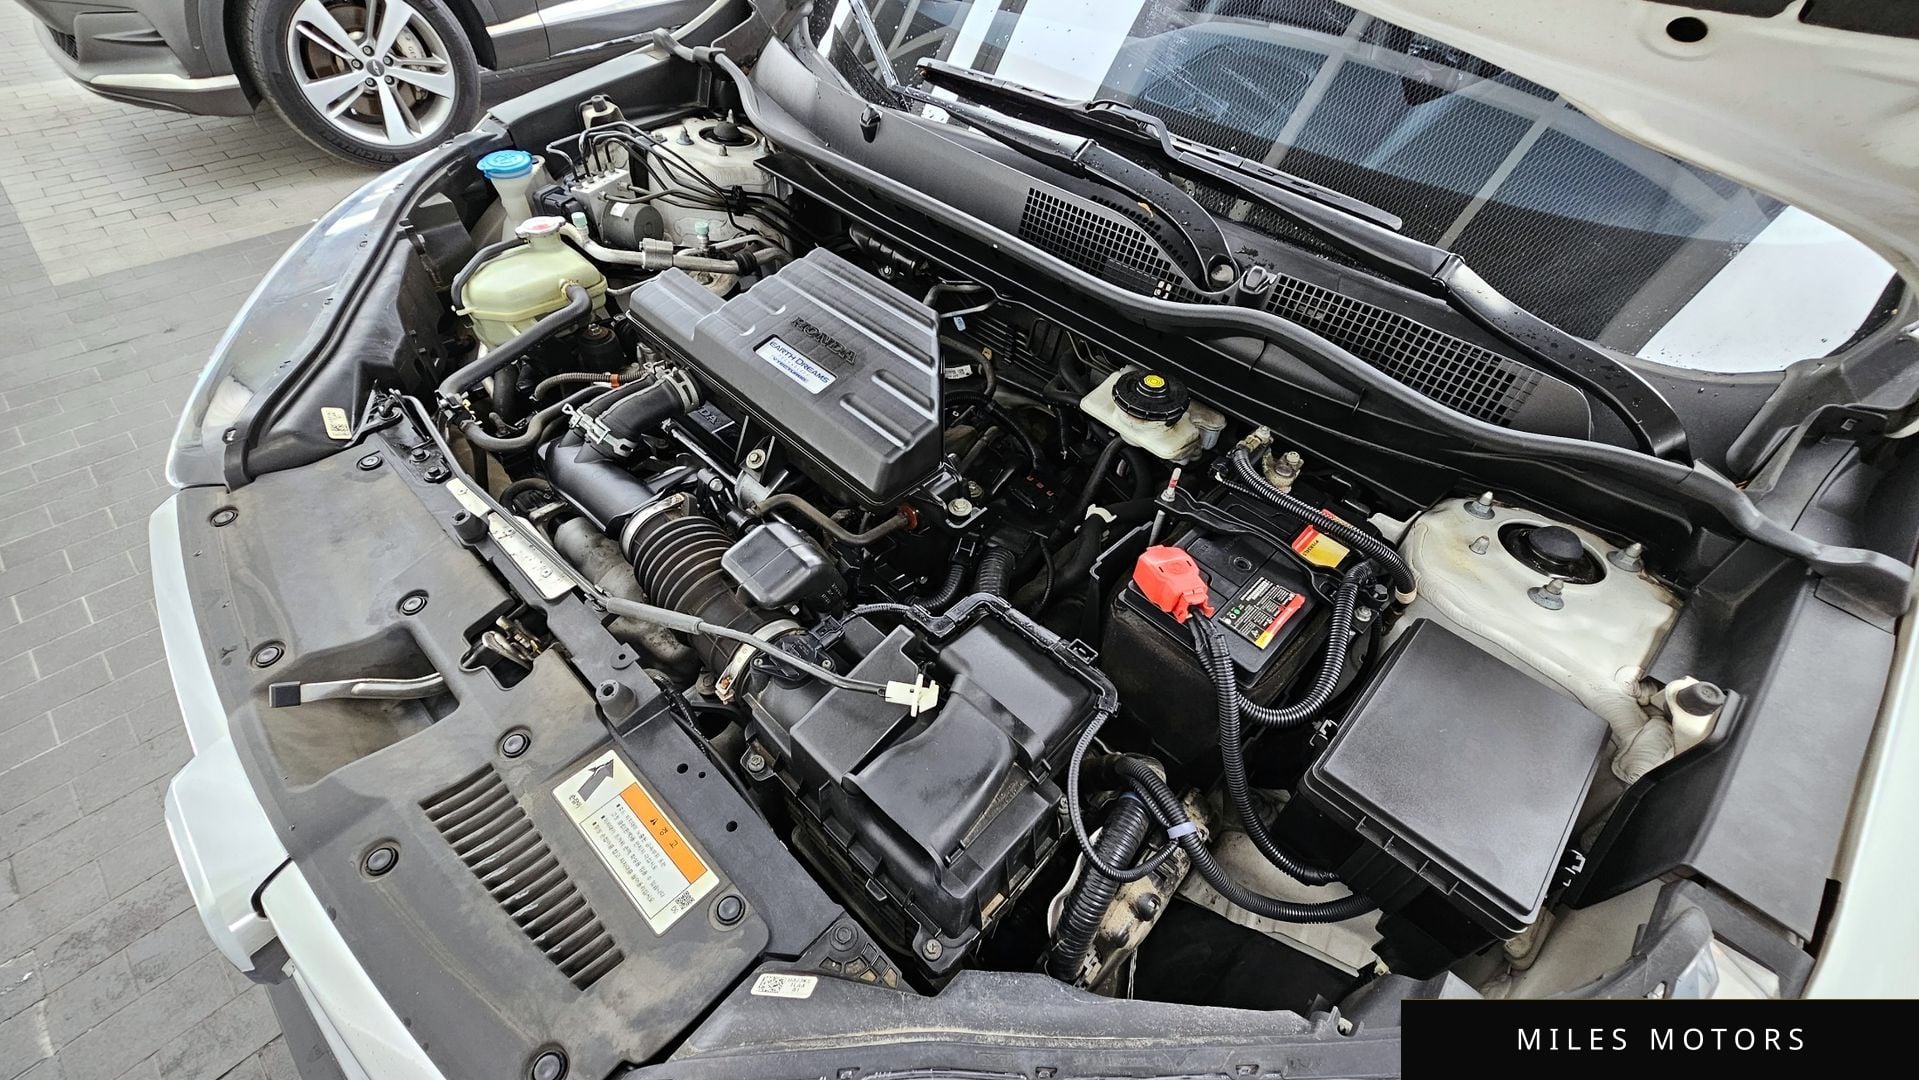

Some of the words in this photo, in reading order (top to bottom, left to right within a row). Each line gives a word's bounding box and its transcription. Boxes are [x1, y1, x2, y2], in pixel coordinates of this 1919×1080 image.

[769, 340, 796, 361] EARTH
[795, 356, 830, 384] DREAMS
[792, 317, 857, 365] HONDA
